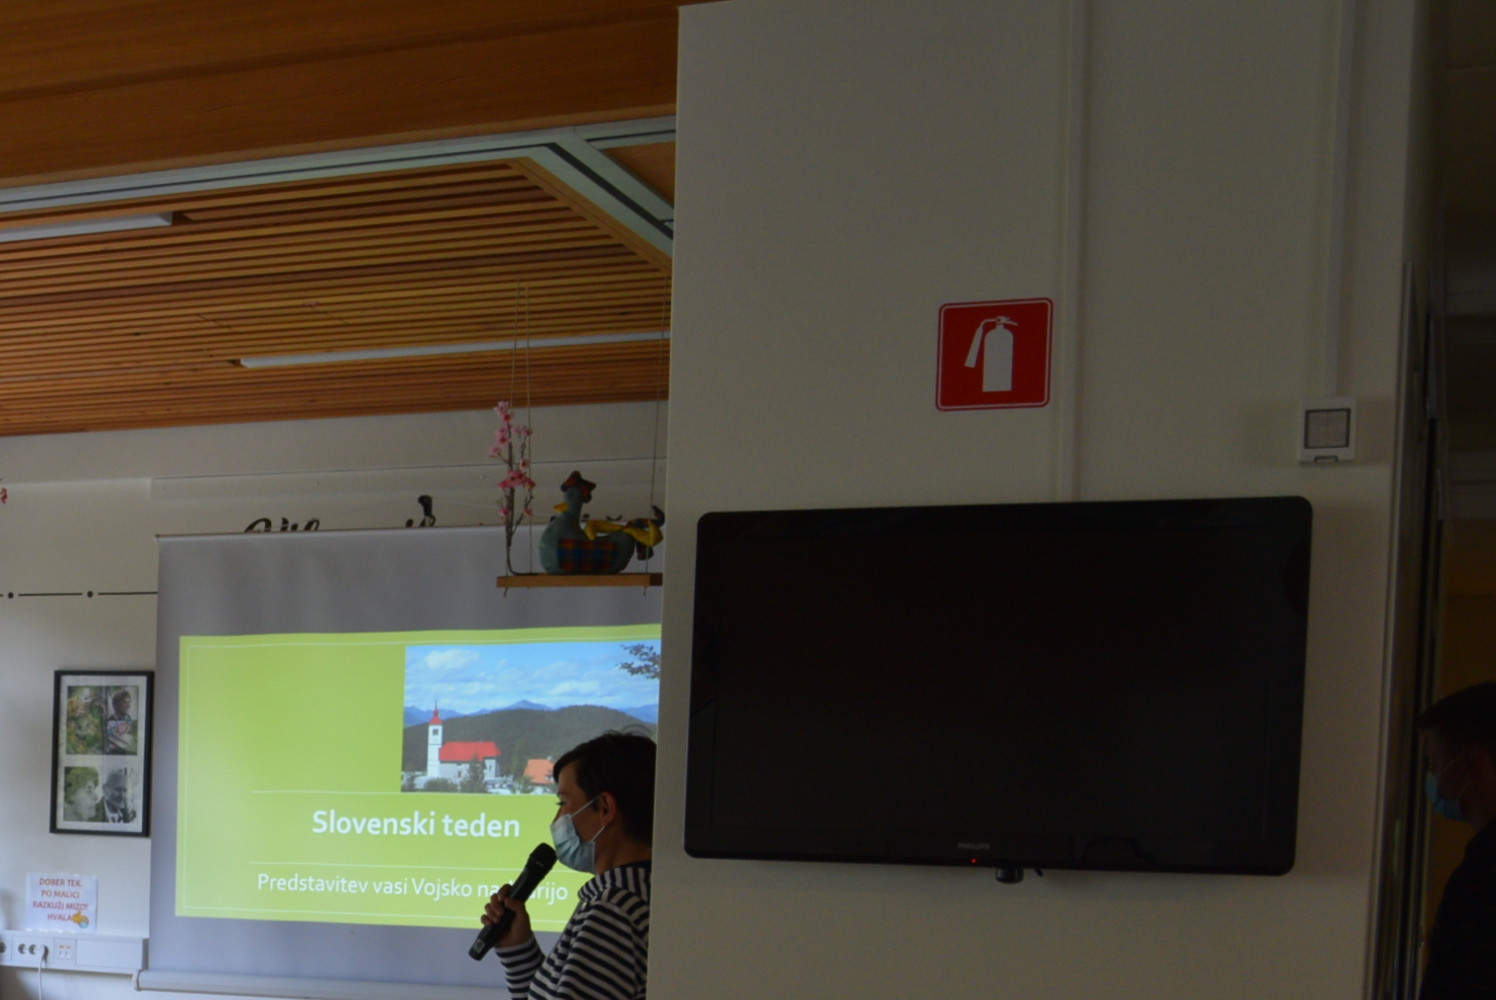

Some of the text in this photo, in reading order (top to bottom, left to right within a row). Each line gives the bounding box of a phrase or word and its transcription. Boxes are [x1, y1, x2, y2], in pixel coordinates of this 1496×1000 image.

[312, 809, 520, 838] Slovenski teden
[39, 877, 65, 886] DOBER
[257, 873, 369, 894] Predstavitev
[373, 877, 408, 896] vasi
[411, 877, 473, 902] Vojsko
[41, 889, 80, 899] PO MALICI
[32, 901, 64, 910] RAZKUŽI
